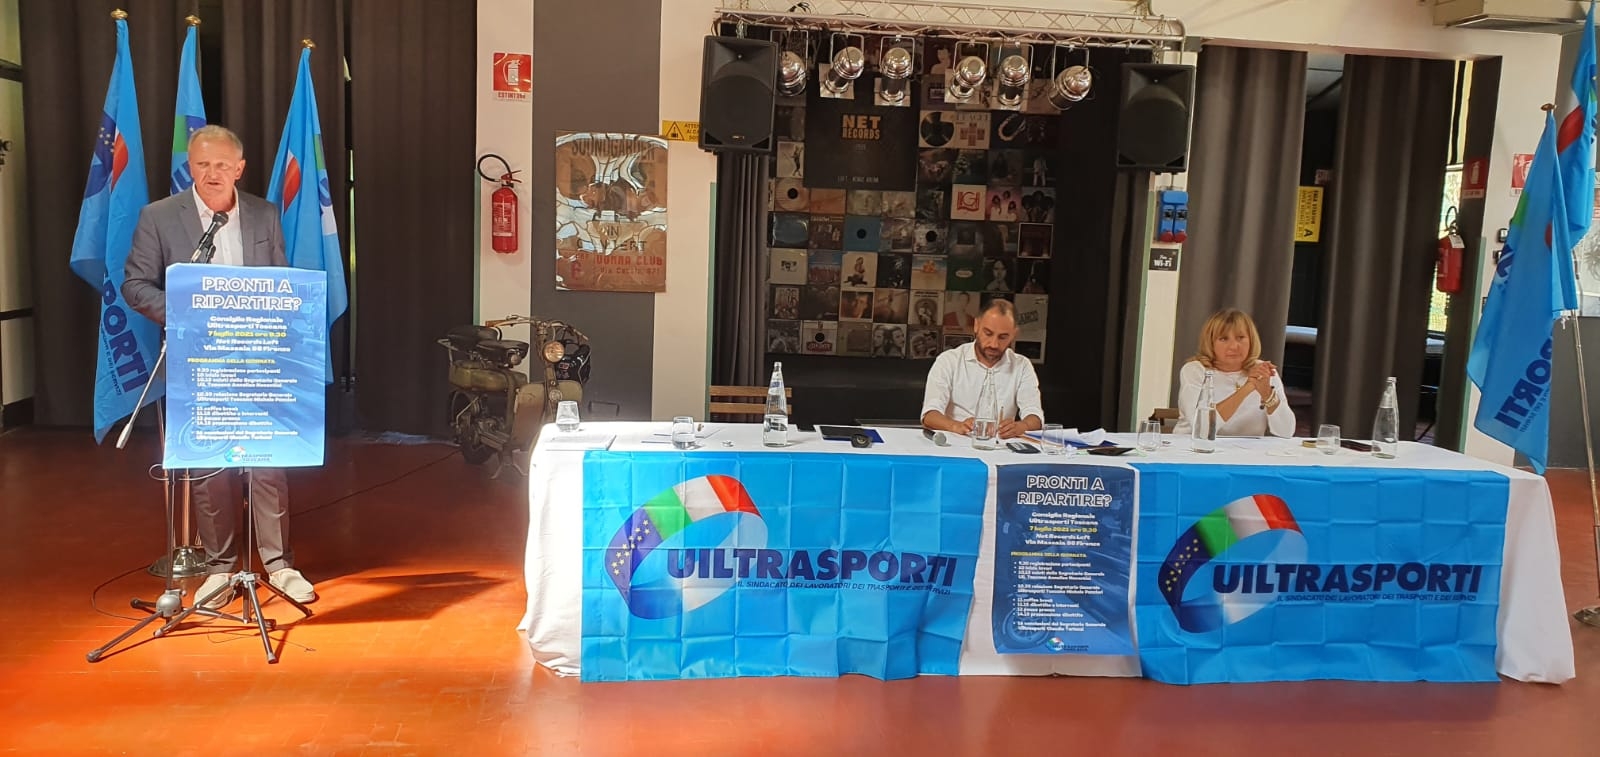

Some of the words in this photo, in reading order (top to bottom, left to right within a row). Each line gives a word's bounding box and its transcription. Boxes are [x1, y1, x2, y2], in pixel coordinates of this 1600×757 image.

[842, 114, 881, 128] NET
[842, 128, 880, 140] RECORDS
[202, 276, 274, 292] PRONTI
[278, 279, 292, 294] A
[192, 294, 302, 311] RIPARTIRE?
[1026, 475, 1088, 490] PRONTI
[1091, 478, 1104, 490] A
[1017, 492, 1112, 507] RIPARTIRE?
[667, 548, 958, 588] UILTRASPORTI
[1213, 562, 1482, 594] UILTRASPORTI
